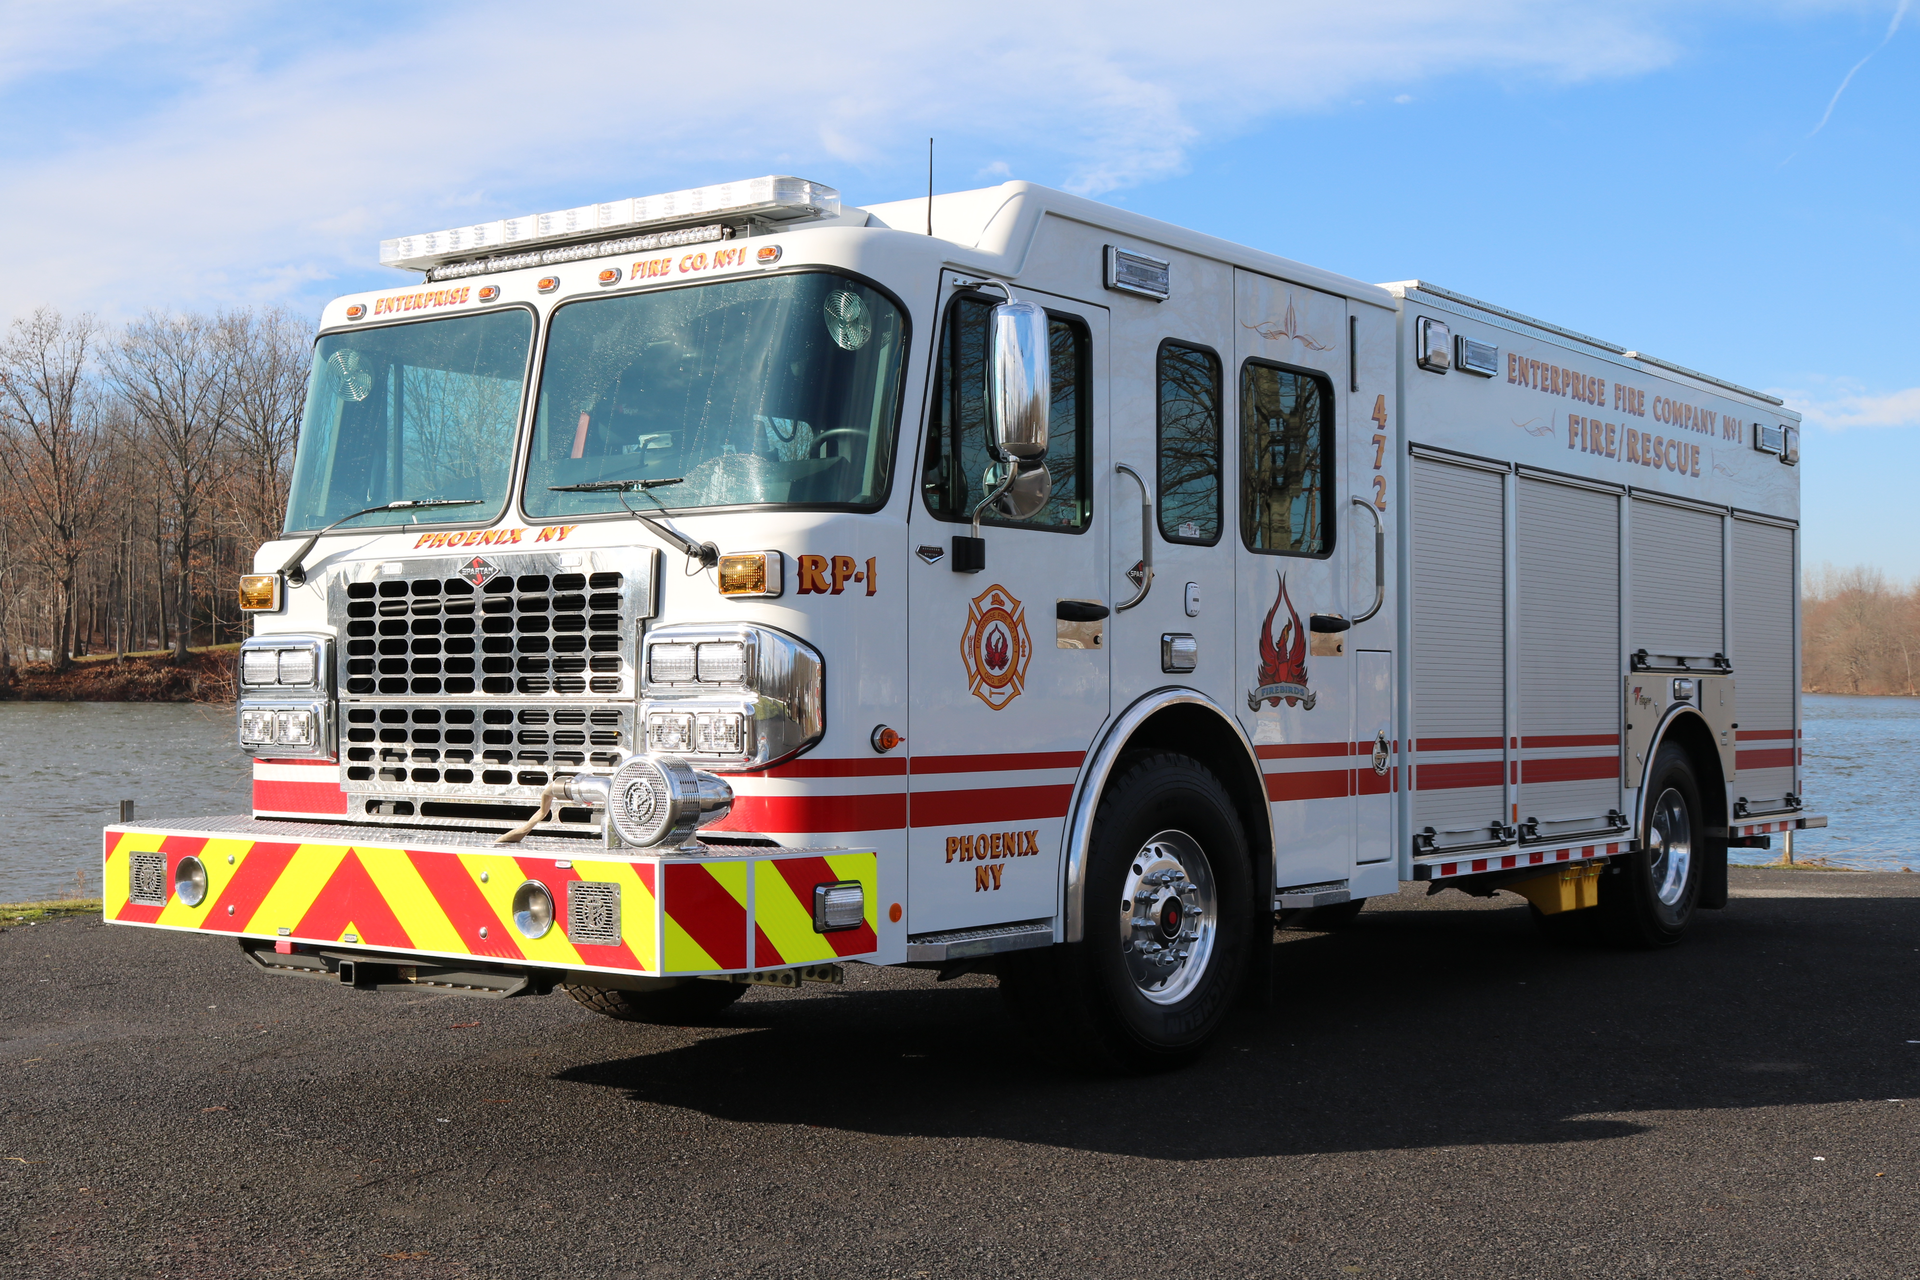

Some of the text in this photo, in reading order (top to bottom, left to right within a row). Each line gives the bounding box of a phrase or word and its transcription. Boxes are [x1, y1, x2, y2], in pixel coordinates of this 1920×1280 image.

[373, 286, 471, 315] ENTERPRISE
[630, 257, 673, 280] FIRE
[678, 252, 709, 273] CO.
[1507, 353, 1606, 407] ENTERPRISE
[1614, 383, 1646, 417] FIRE
[1653, 395, 1717, 436] COMPANY
[1568, 413, 1701, 478] FIRE/RESCUE
[413, 525, 579, 549] PHOENIX NY
[461, 567, 494, 575] SPARTAN
[796, 554, 877, 597] RP-1
[997, 612, 1008, 622] FIRE
[1261, 685, 1305, 697] FIREBIRDS
[945, 830, 1039, 863] PHOENIX
[975, 863, 1005, 892] NY
